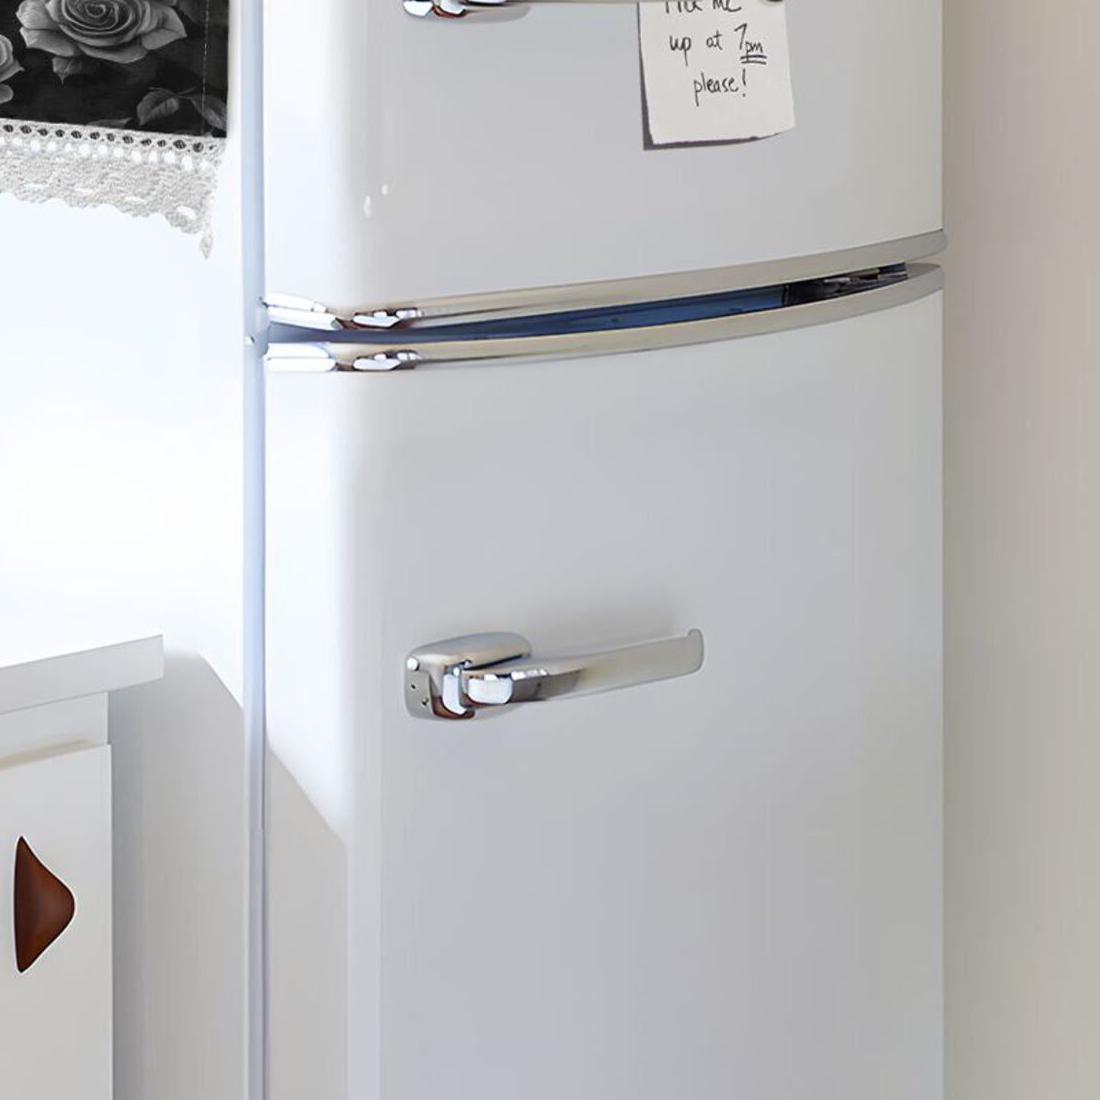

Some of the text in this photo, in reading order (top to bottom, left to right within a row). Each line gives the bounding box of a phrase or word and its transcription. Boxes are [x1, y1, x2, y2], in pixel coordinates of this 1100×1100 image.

[669, 35, 692, 66] up
[706, 30, 723, 50] at
[693, 68, 747, 107] please!
